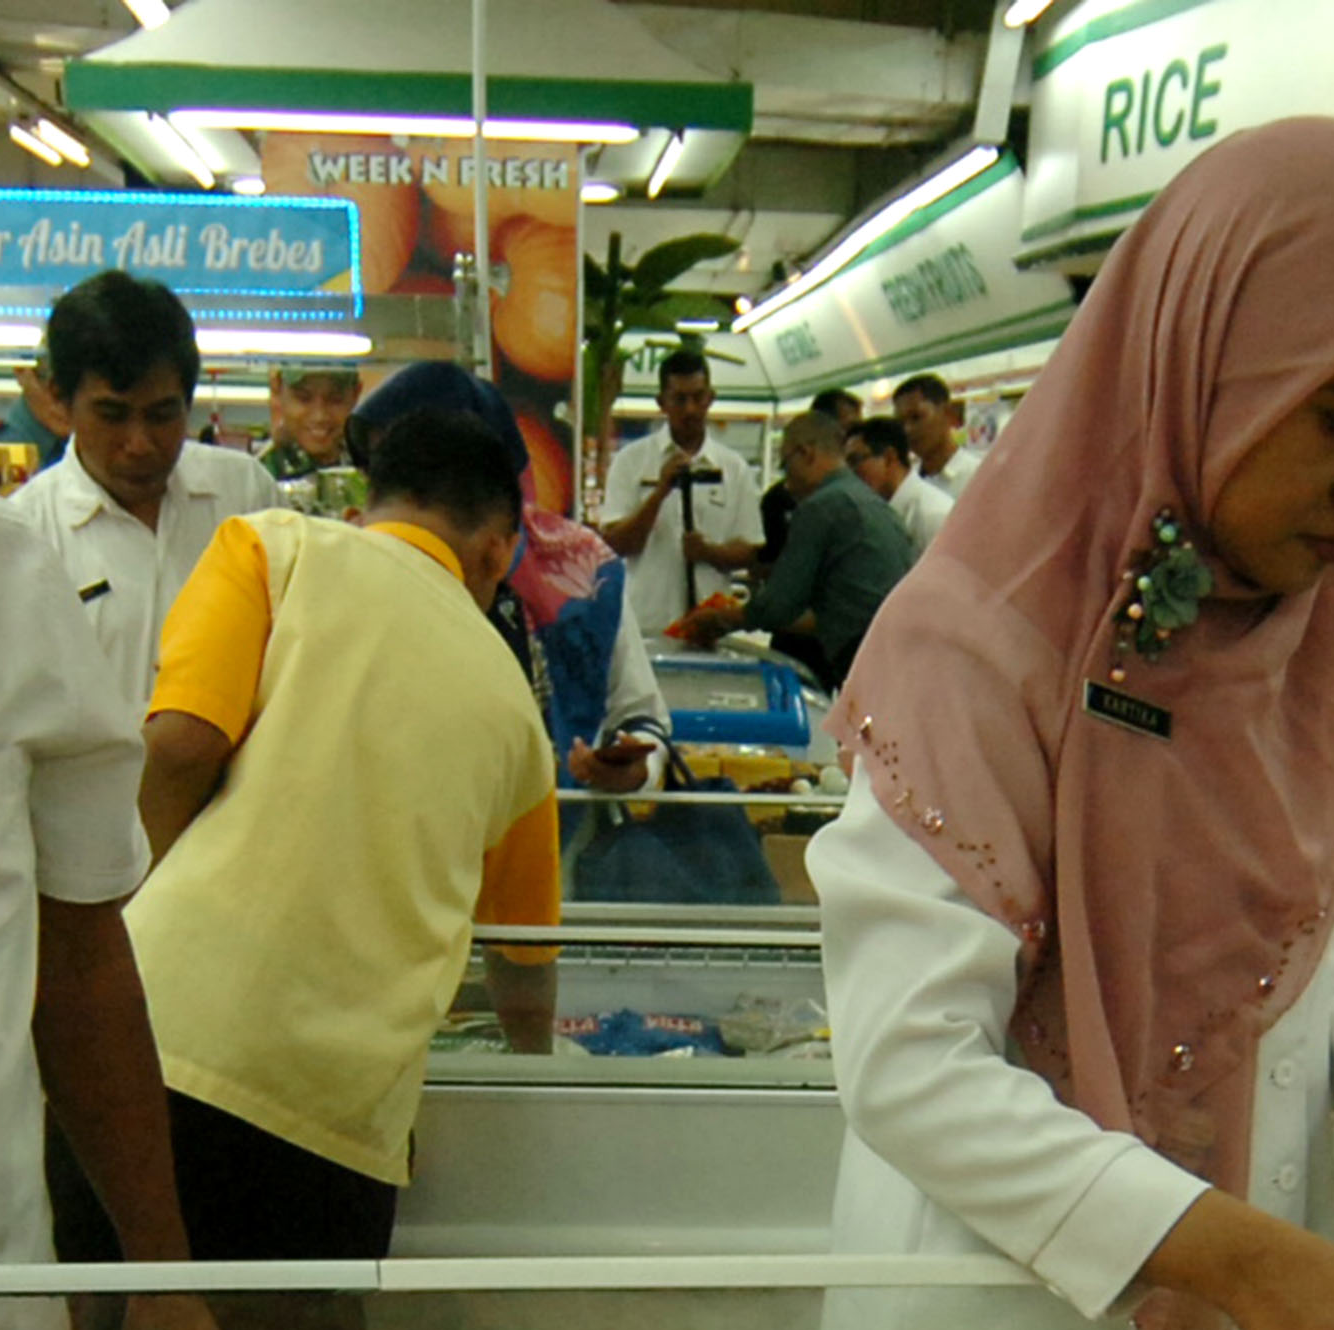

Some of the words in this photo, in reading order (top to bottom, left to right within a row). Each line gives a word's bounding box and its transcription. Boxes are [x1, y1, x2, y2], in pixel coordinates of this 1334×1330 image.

[1101, 43, 1229, 164] RICE
[310, 150, 413, 187] WEEK
[422, 156, 449, 185] N
[460, 156, 568, 189] FRESH
[18, 218, 104, 269] Asin
[113, 220, 189, 270] Asli
[199, 222, 324, 272] Brebes
